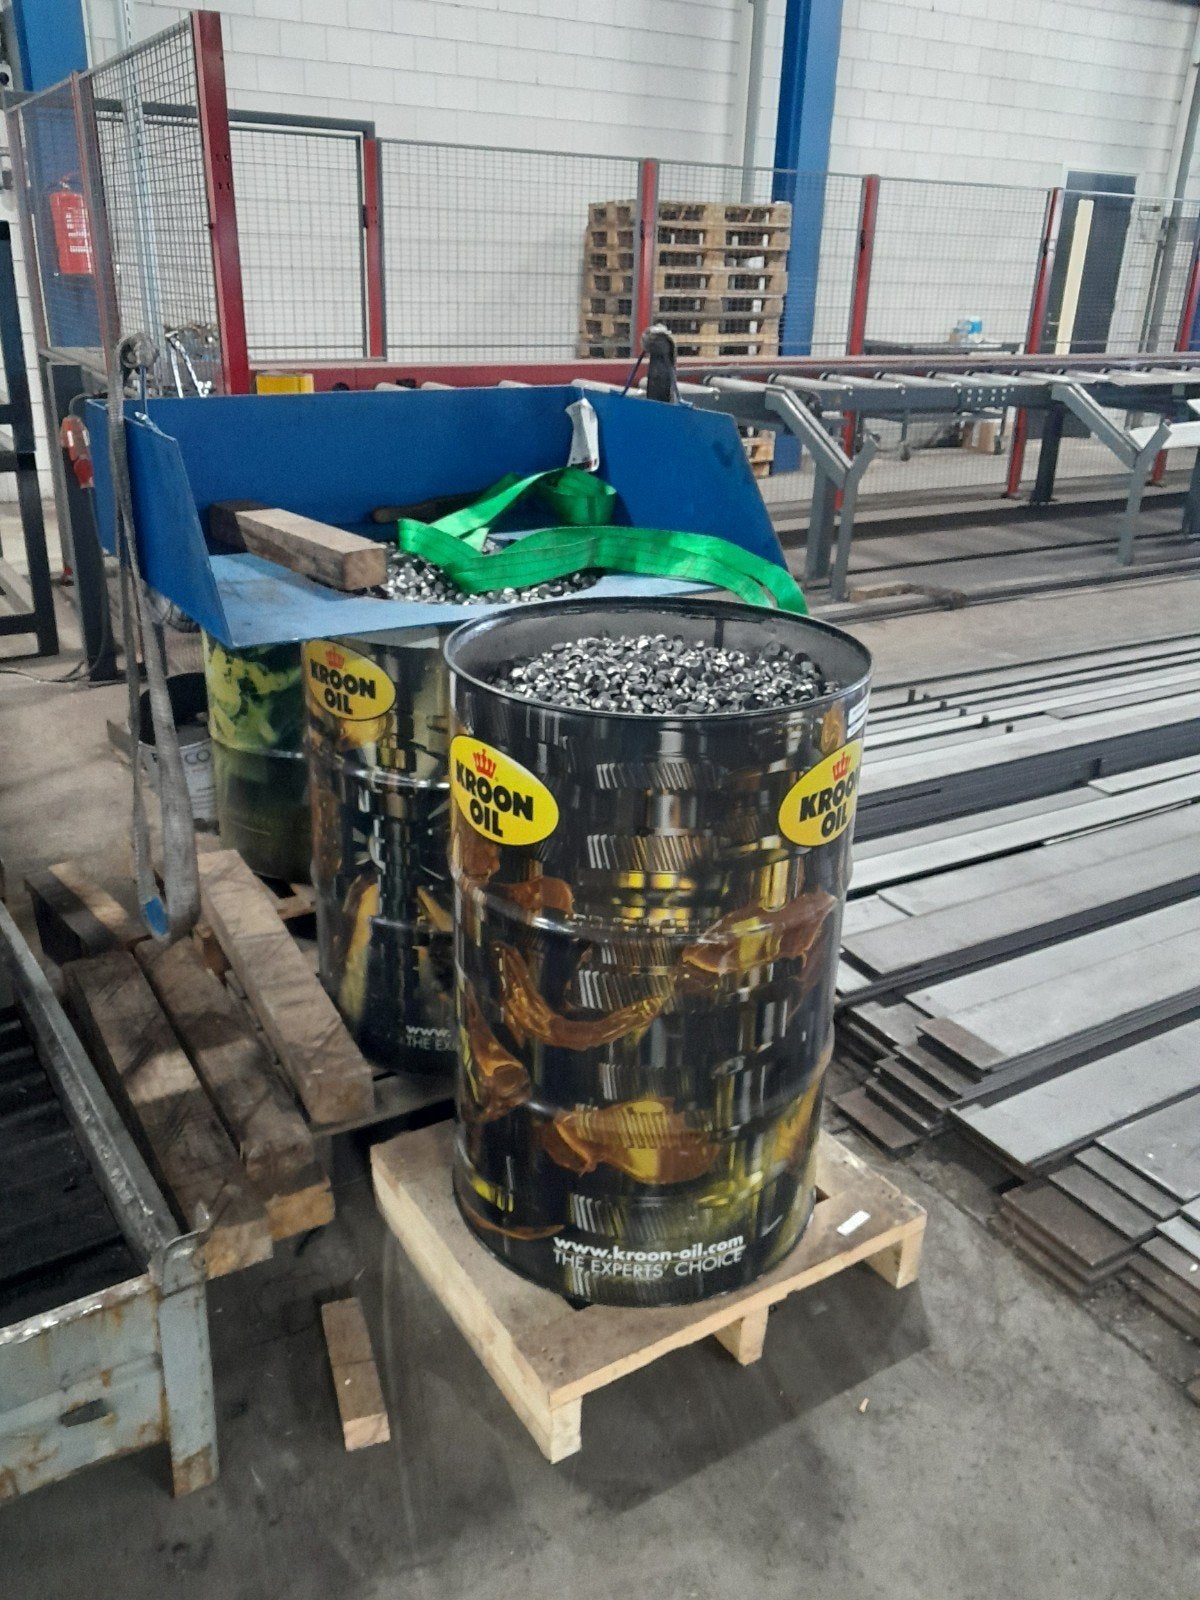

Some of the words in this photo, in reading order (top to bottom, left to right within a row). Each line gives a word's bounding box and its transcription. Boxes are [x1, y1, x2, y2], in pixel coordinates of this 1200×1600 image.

[310, 658, 376, 700] KROON
[324, 688, 353, 715] OIL
[456, 758, 534, 822] KROON
[469, 798, 503, 838] OIL
[821, 801, 847, 838] OIL
[553, 1236, 744, 1262] www.kroon-oil.com
[553, 1249, 585, 1270] THE
[674, 1246, 744, 1277] CHOICE
